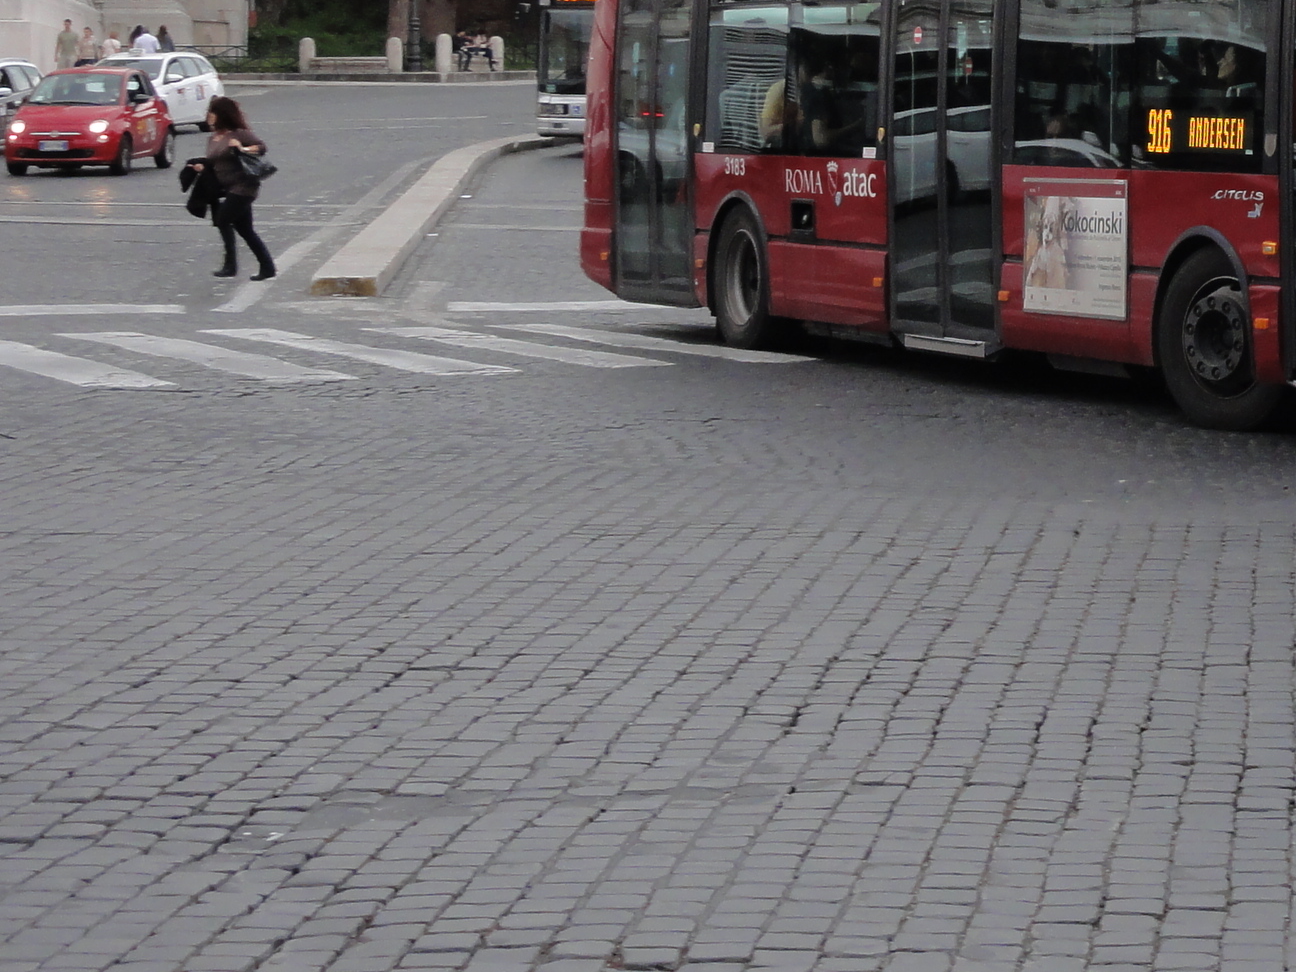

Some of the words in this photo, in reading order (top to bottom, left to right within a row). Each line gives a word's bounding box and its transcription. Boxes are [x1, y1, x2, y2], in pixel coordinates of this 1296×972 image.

[1147, 108, 1172, 153] 916
[1188, 117, 1245, 150] ANDERSEN
[724, 156, 746, 176] 3183
[785, 168, 823, 194] ROMA
[843, 167, 876, 198] atac
[1060, 209, 1123, 235] Kokocinski
